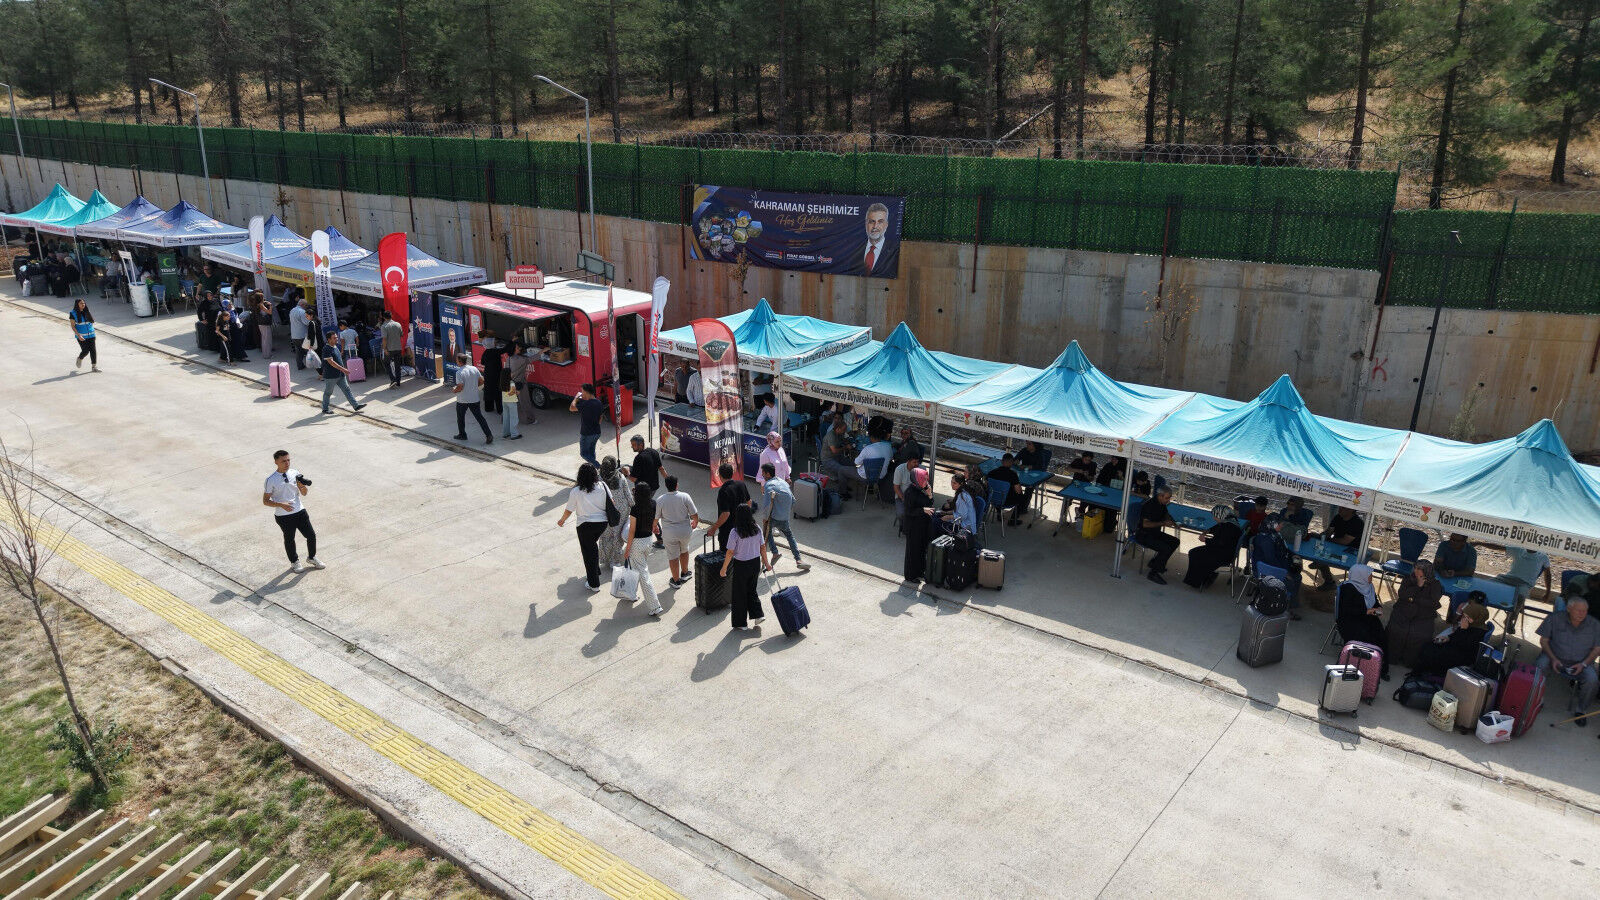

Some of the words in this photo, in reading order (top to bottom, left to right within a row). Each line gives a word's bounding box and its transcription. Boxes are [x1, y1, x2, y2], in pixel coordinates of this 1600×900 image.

[754, 200, 805, 213] KAHRAMAN
[807, 203, 860, 216] ŞEHRİMİZE
[775, 213, 795, 227] Hoş
[797, 213, 834, 226] Geldiniz
[687, 431, 707, 440] ALPEDO
[975, 415, 1020, 434] Kahramanmaraş
[1021, 423, 1053, 439] Büyükşehir
[1054, 429, 1085, 445] Belediyesi
[1180, 453, 1235, 476] Kahramanmaraş
[1235, 464, 1276, 482] Büyükşehir
[1276, 474, 1315, 492] Belediyesi
[1437, 510, 1509, 540] Kahramanmaraş
[1510, 525, 1563, 547] Büyükşehir
